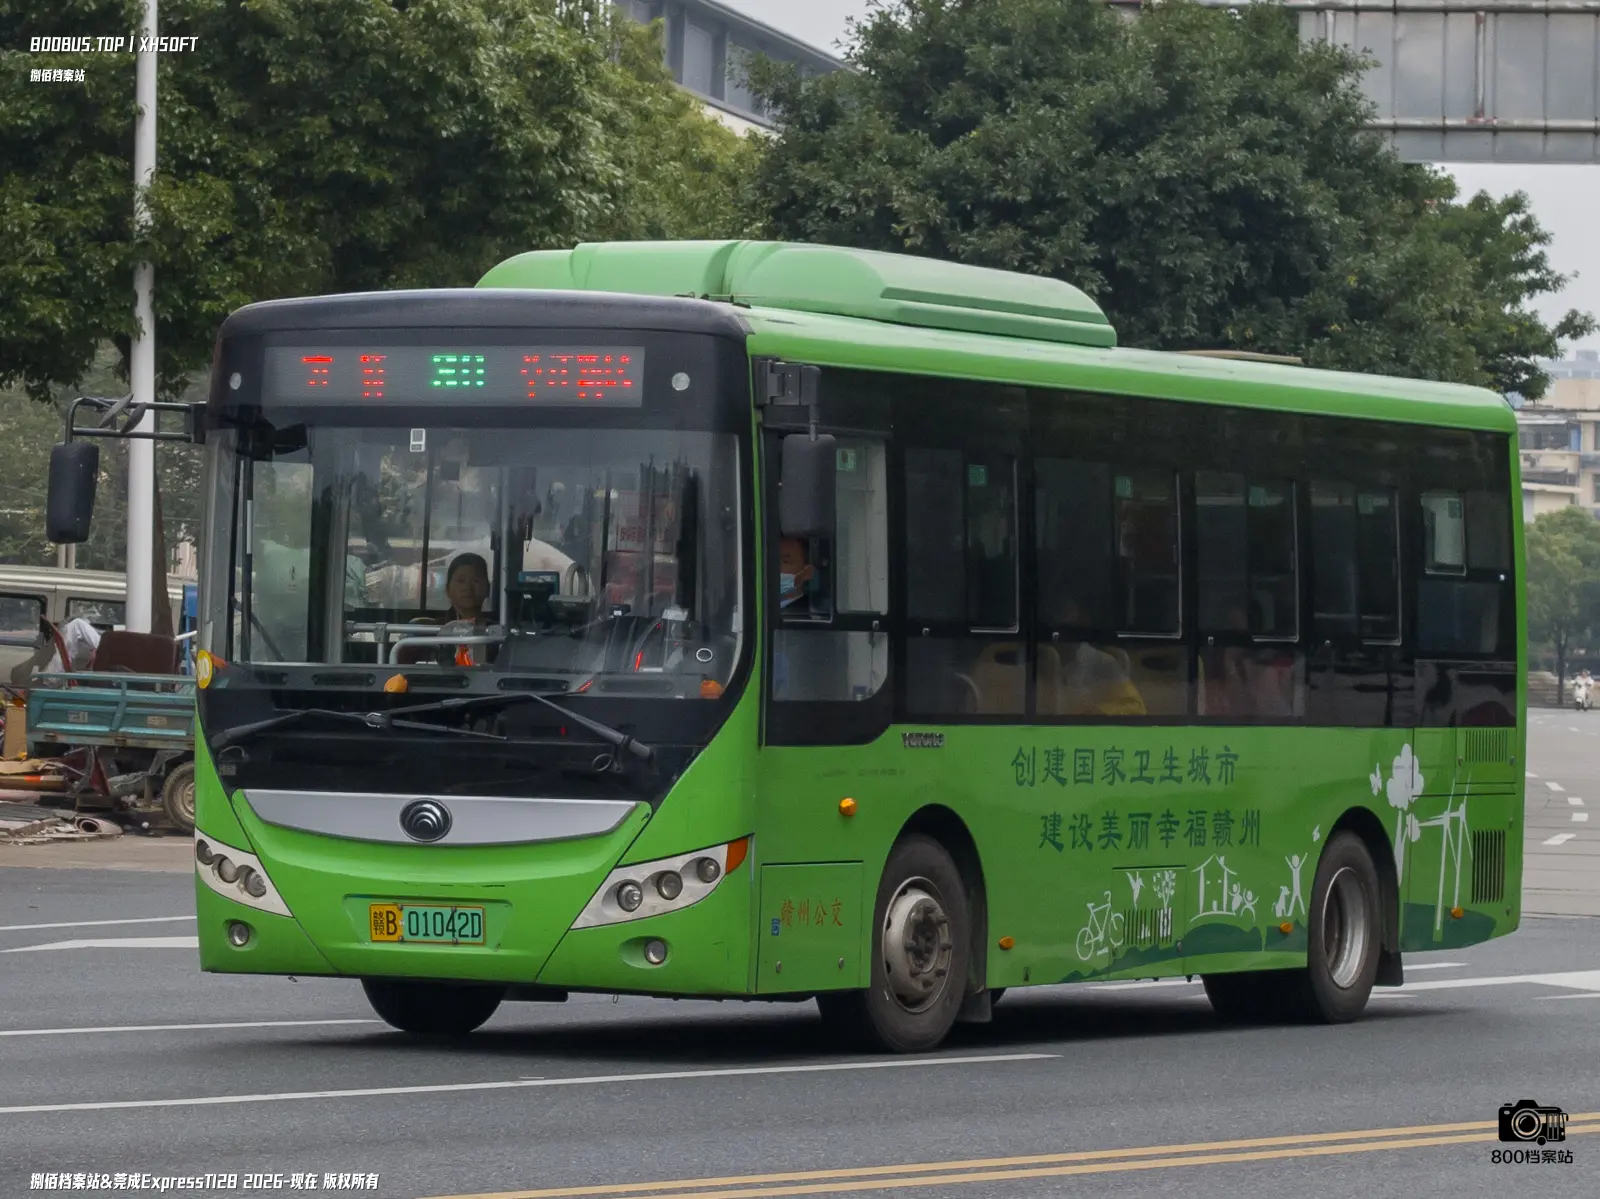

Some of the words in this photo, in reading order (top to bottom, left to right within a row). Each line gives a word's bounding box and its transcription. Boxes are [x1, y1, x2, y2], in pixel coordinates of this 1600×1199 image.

[1011, 745, 1240, 788] 创建国家卫生城市
[1038, 808, 1262, 852] 建设美丽幸福赣州
